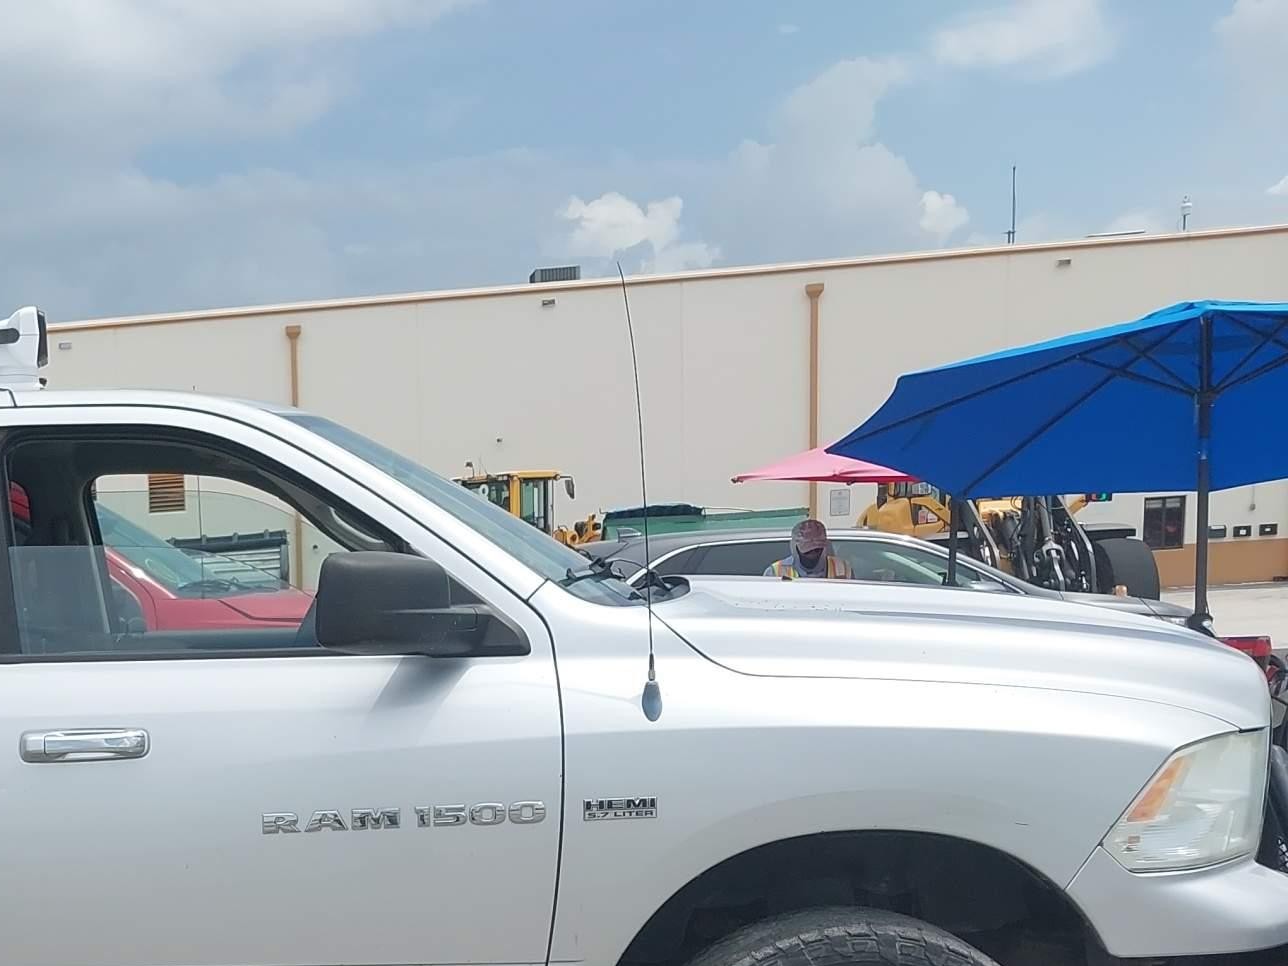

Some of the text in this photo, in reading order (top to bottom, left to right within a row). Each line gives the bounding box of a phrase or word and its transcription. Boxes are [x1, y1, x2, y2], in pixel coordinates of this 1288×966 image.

[584, 797, 656, 810] HEMI
[261, 800, 546, 834] RAM 1500
[613, 810, 654, 818] LITER
